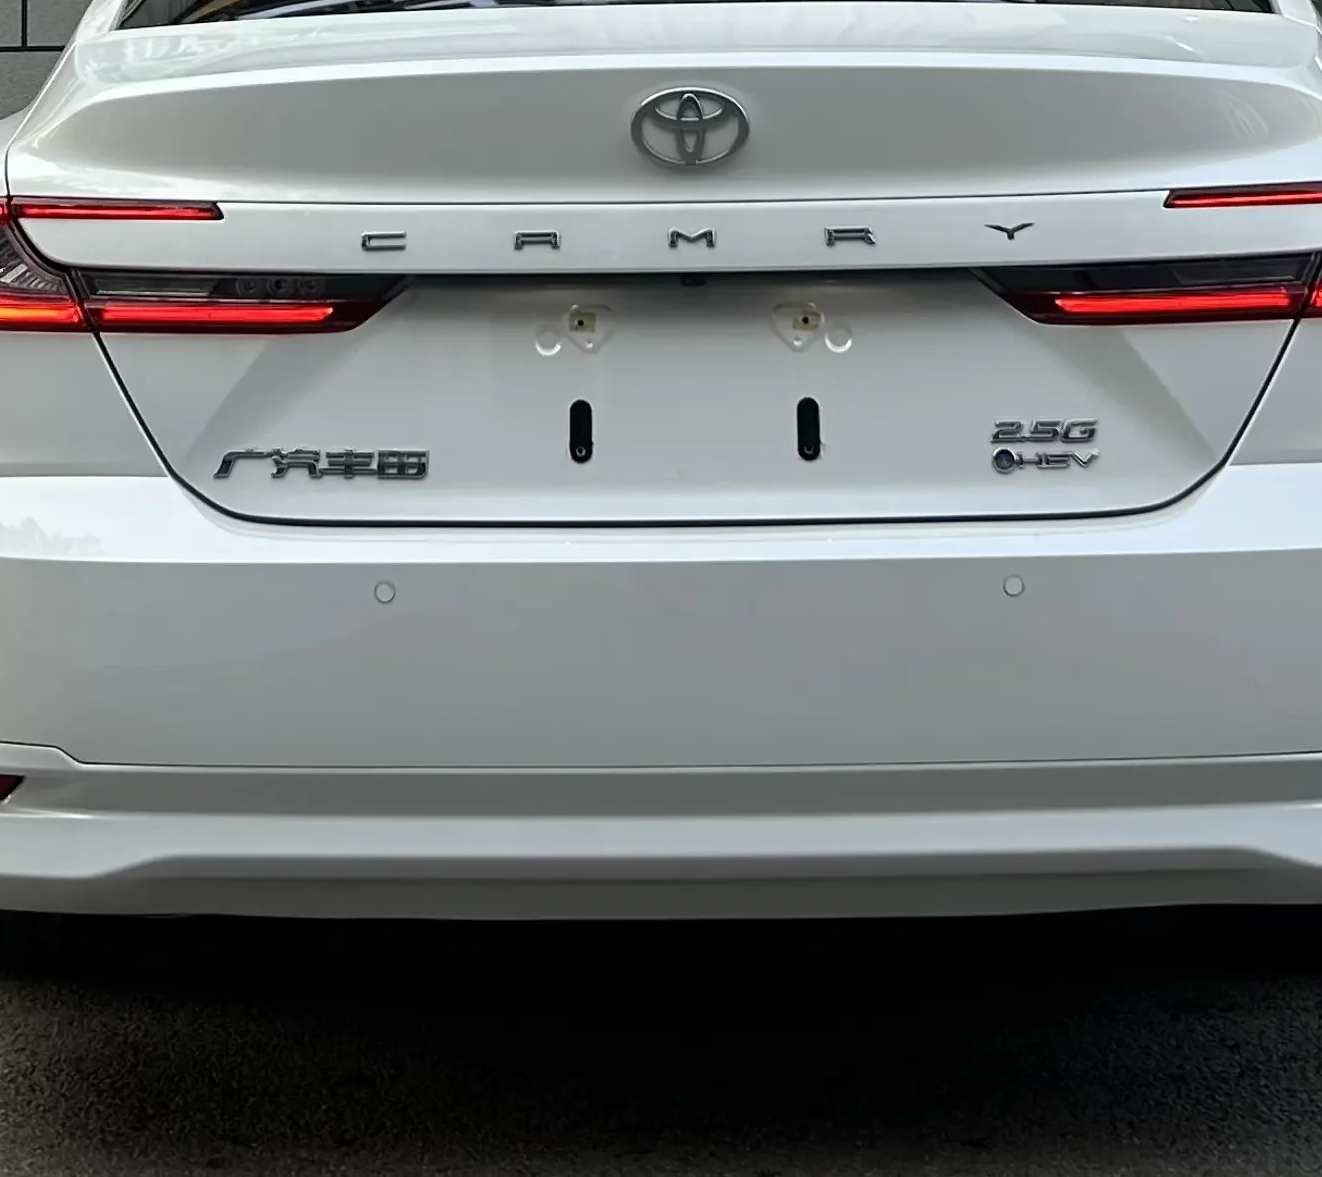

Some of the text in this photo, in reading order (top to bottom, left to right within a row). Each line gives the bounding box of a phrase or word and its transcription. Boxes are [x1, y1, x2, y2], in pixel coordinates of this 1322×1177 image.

[360, 222, 1036, 251] CAMRY
[213, 448, 430, 480] 广汽丰田
